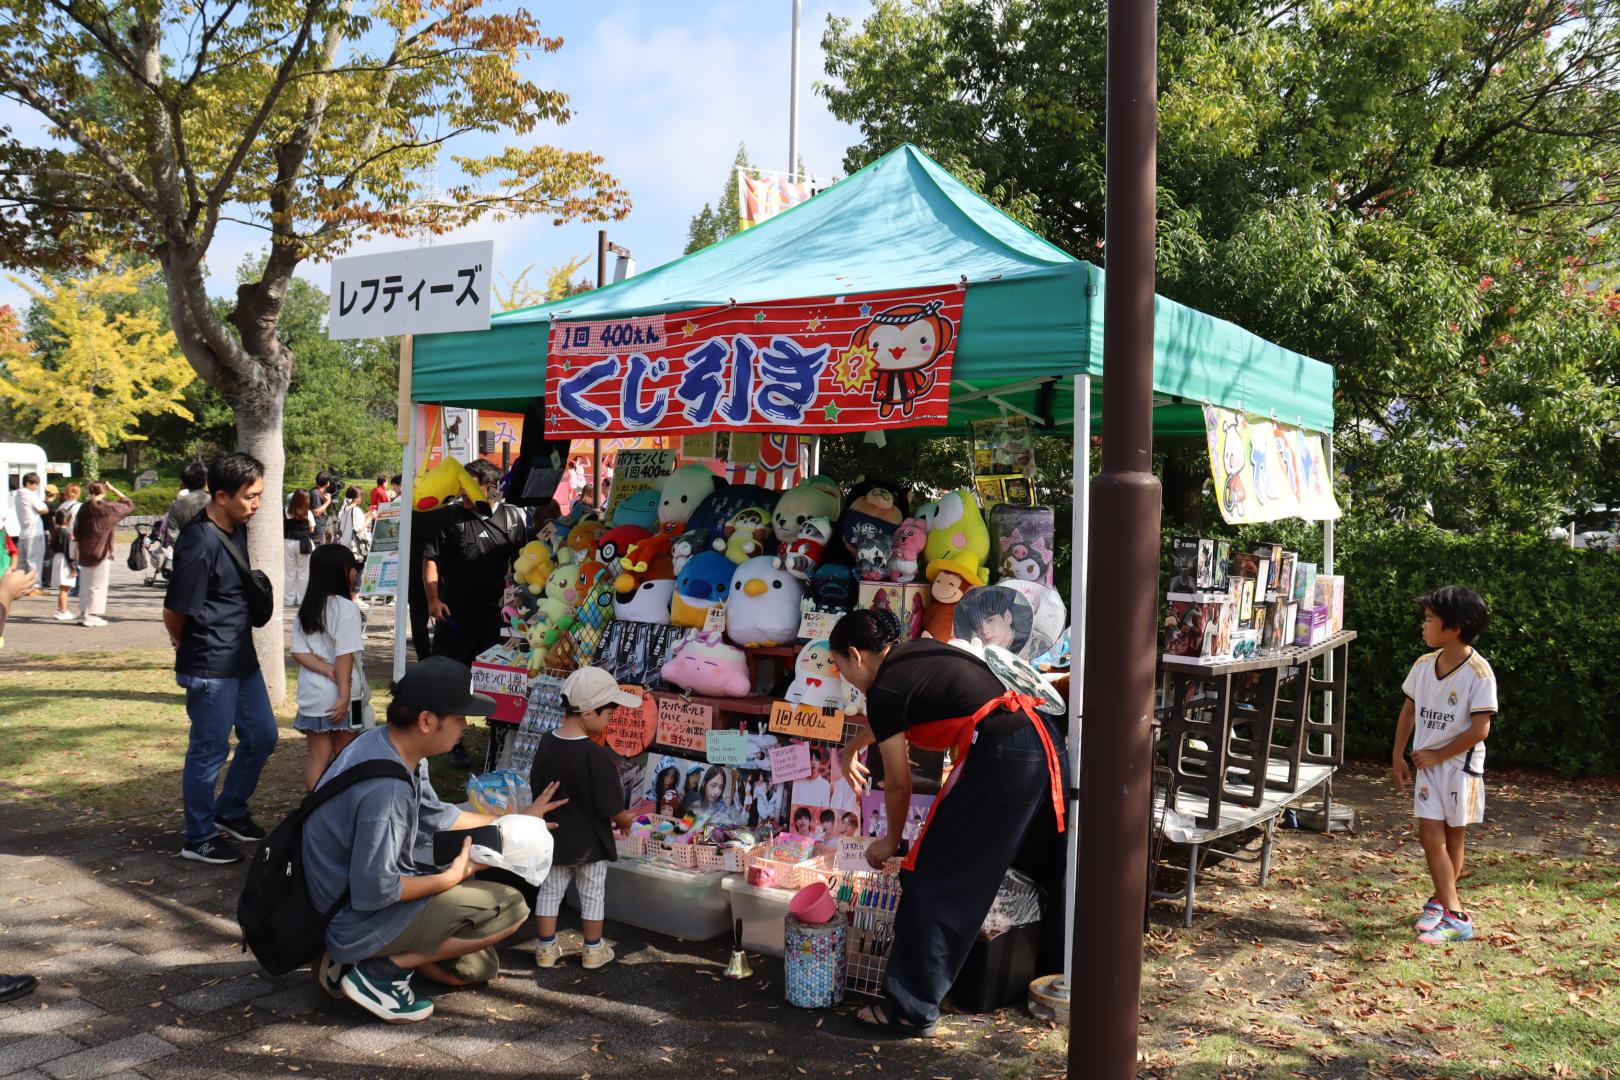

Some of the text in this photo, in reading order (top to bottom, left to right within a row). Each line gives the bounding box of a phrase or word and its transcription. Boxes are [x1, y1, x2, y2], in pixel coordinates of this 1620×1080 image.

[339, 264, 484, 317] レフティーズ
[557, 333, 832, 431] くじ引き
[617, 451, 670, 466] ポケモンくじ
[775, 709, 793, 726] 1回
[670, 733, 693, 747] 当たり
